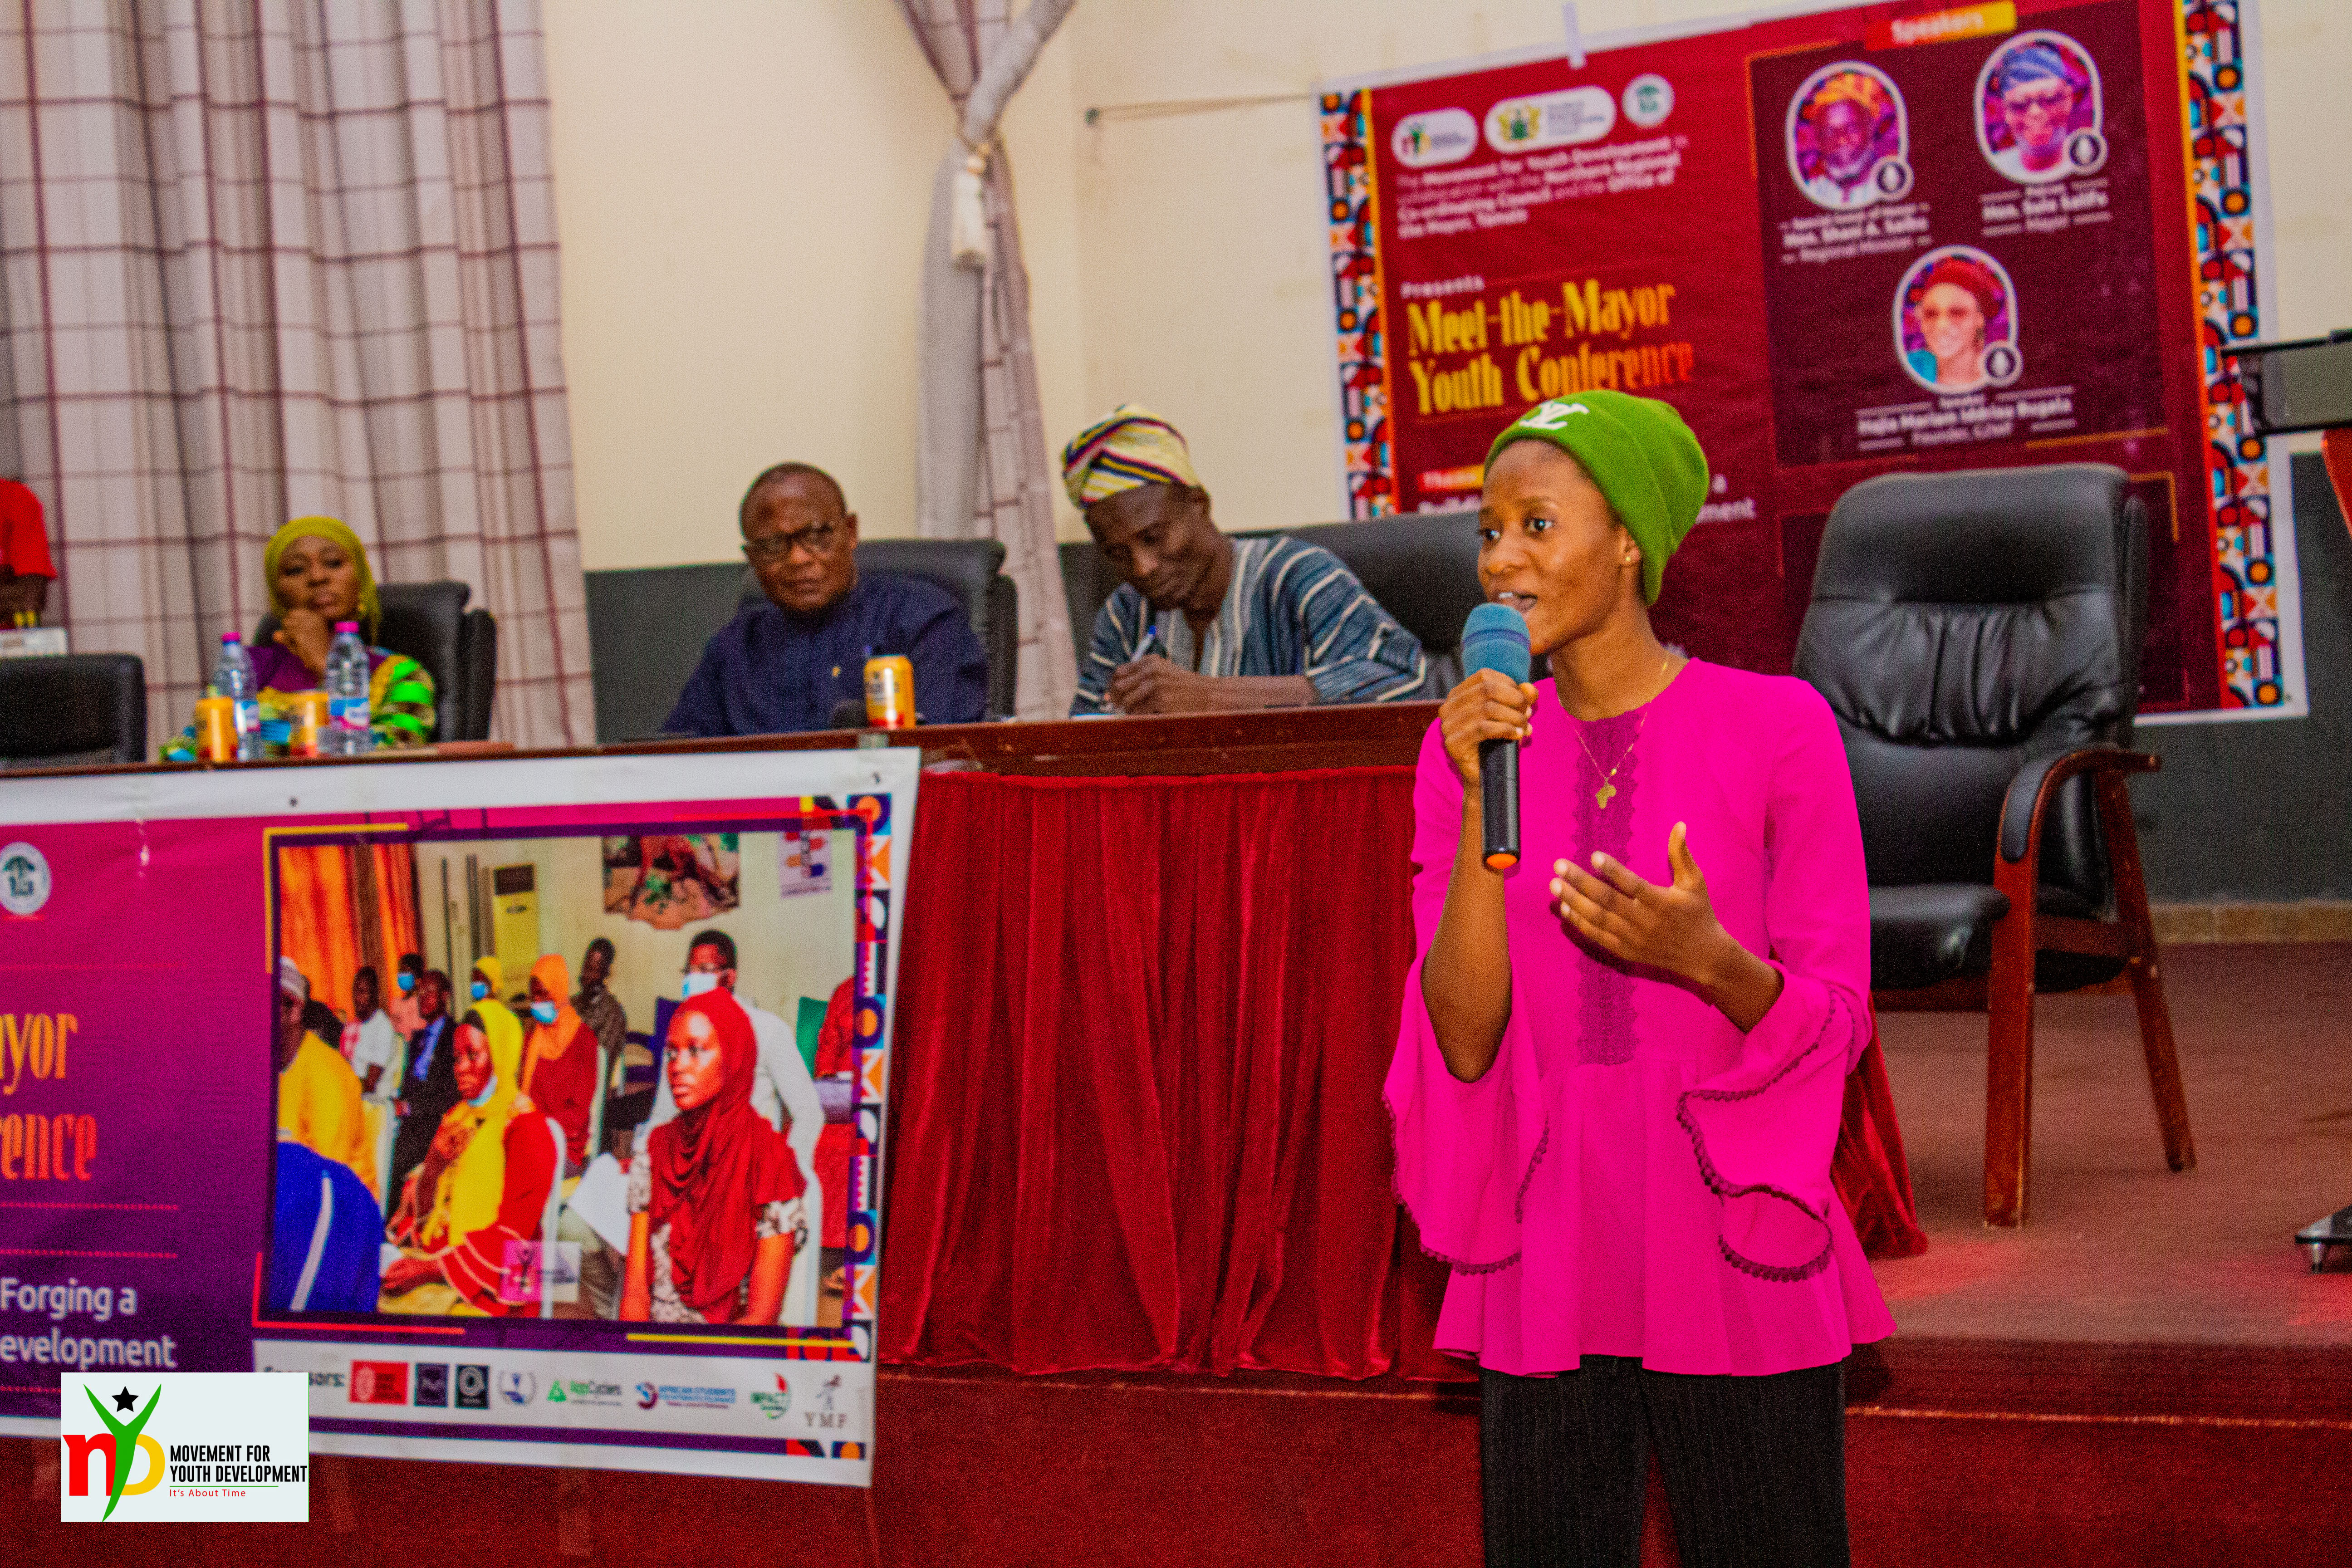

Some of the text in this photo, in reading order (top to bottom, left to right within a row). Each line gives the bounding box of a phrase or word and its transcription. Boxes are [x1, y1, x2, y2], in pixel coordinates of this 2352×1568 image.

[1407, 279, 1676, 357] Meet-the-Mayor
[1408, 342, 1693, 415] Youth Conference
[0, 1114, 98, 1181] ence
[0, 1277, 137, 1322] Forging a
[0, 1327, 178, 1371] evelopment
